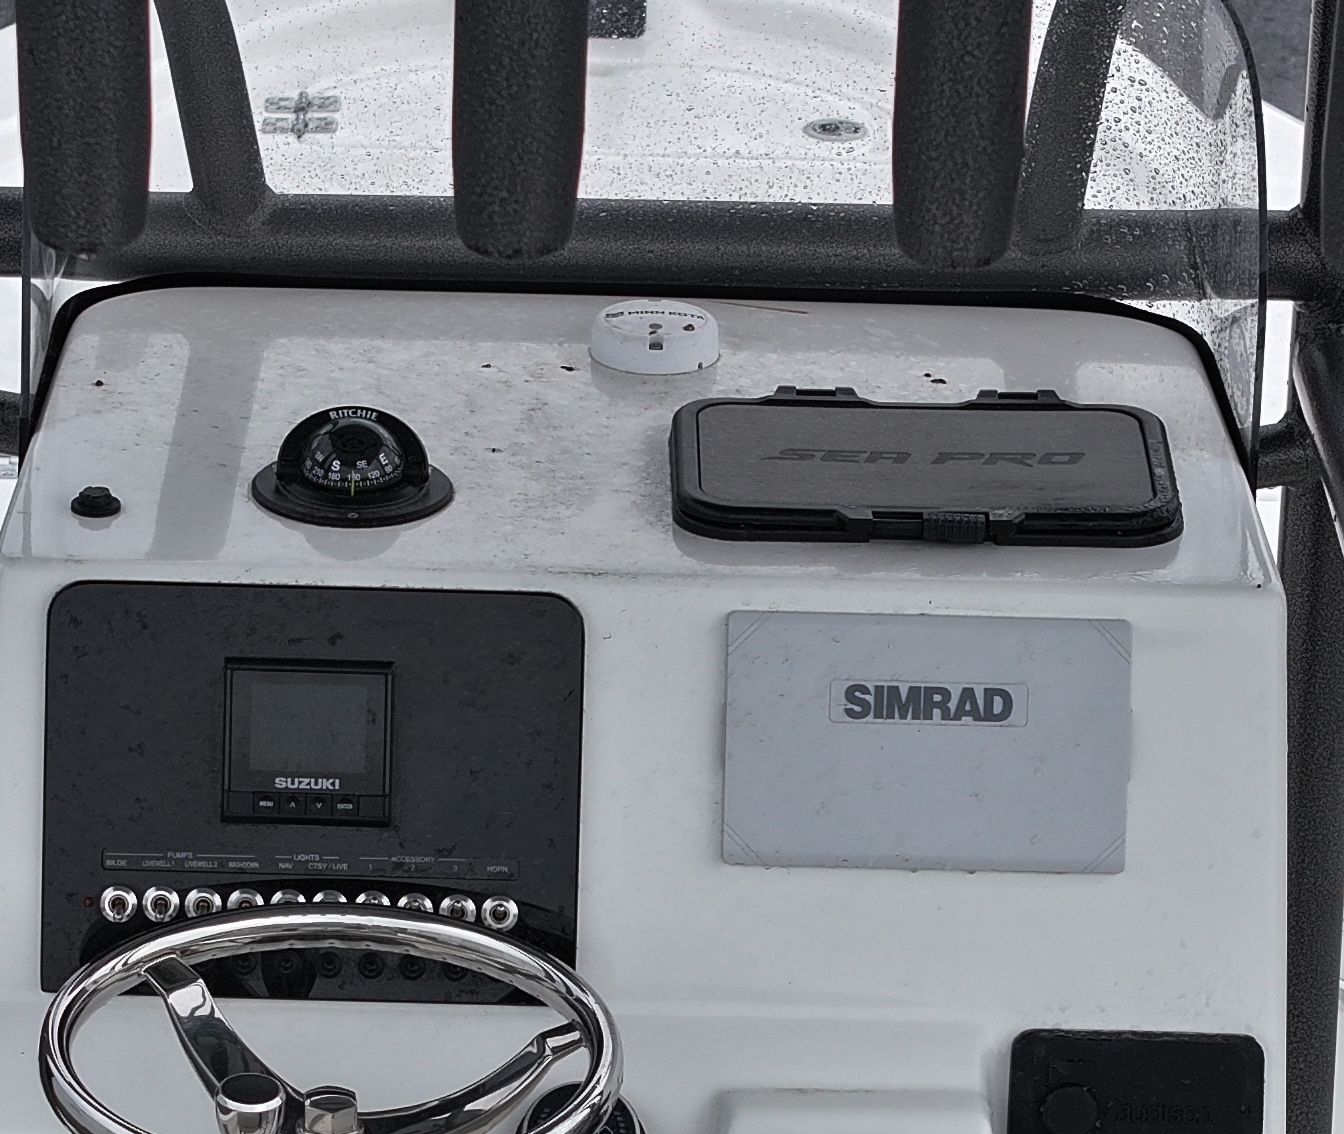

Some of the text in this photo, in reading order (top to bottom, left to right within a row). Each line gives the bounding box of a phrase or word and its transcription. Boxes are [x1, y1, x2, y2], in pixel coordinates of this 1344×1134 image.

[329, 409, 379, 420] RITCHIE
[760, 447, 1086, 467] SEA PRO
[331, 460, 341, 471] S
[356, 460, 368, 469] SE
[328, 472, 341, 481] 180
[368, 470, 380, 479] 120
[843, 683, 1014, 723] SIMRAD
[274, 777, 340, 790] SUZUKI
[167, 851, 193, 859] PUMPS
